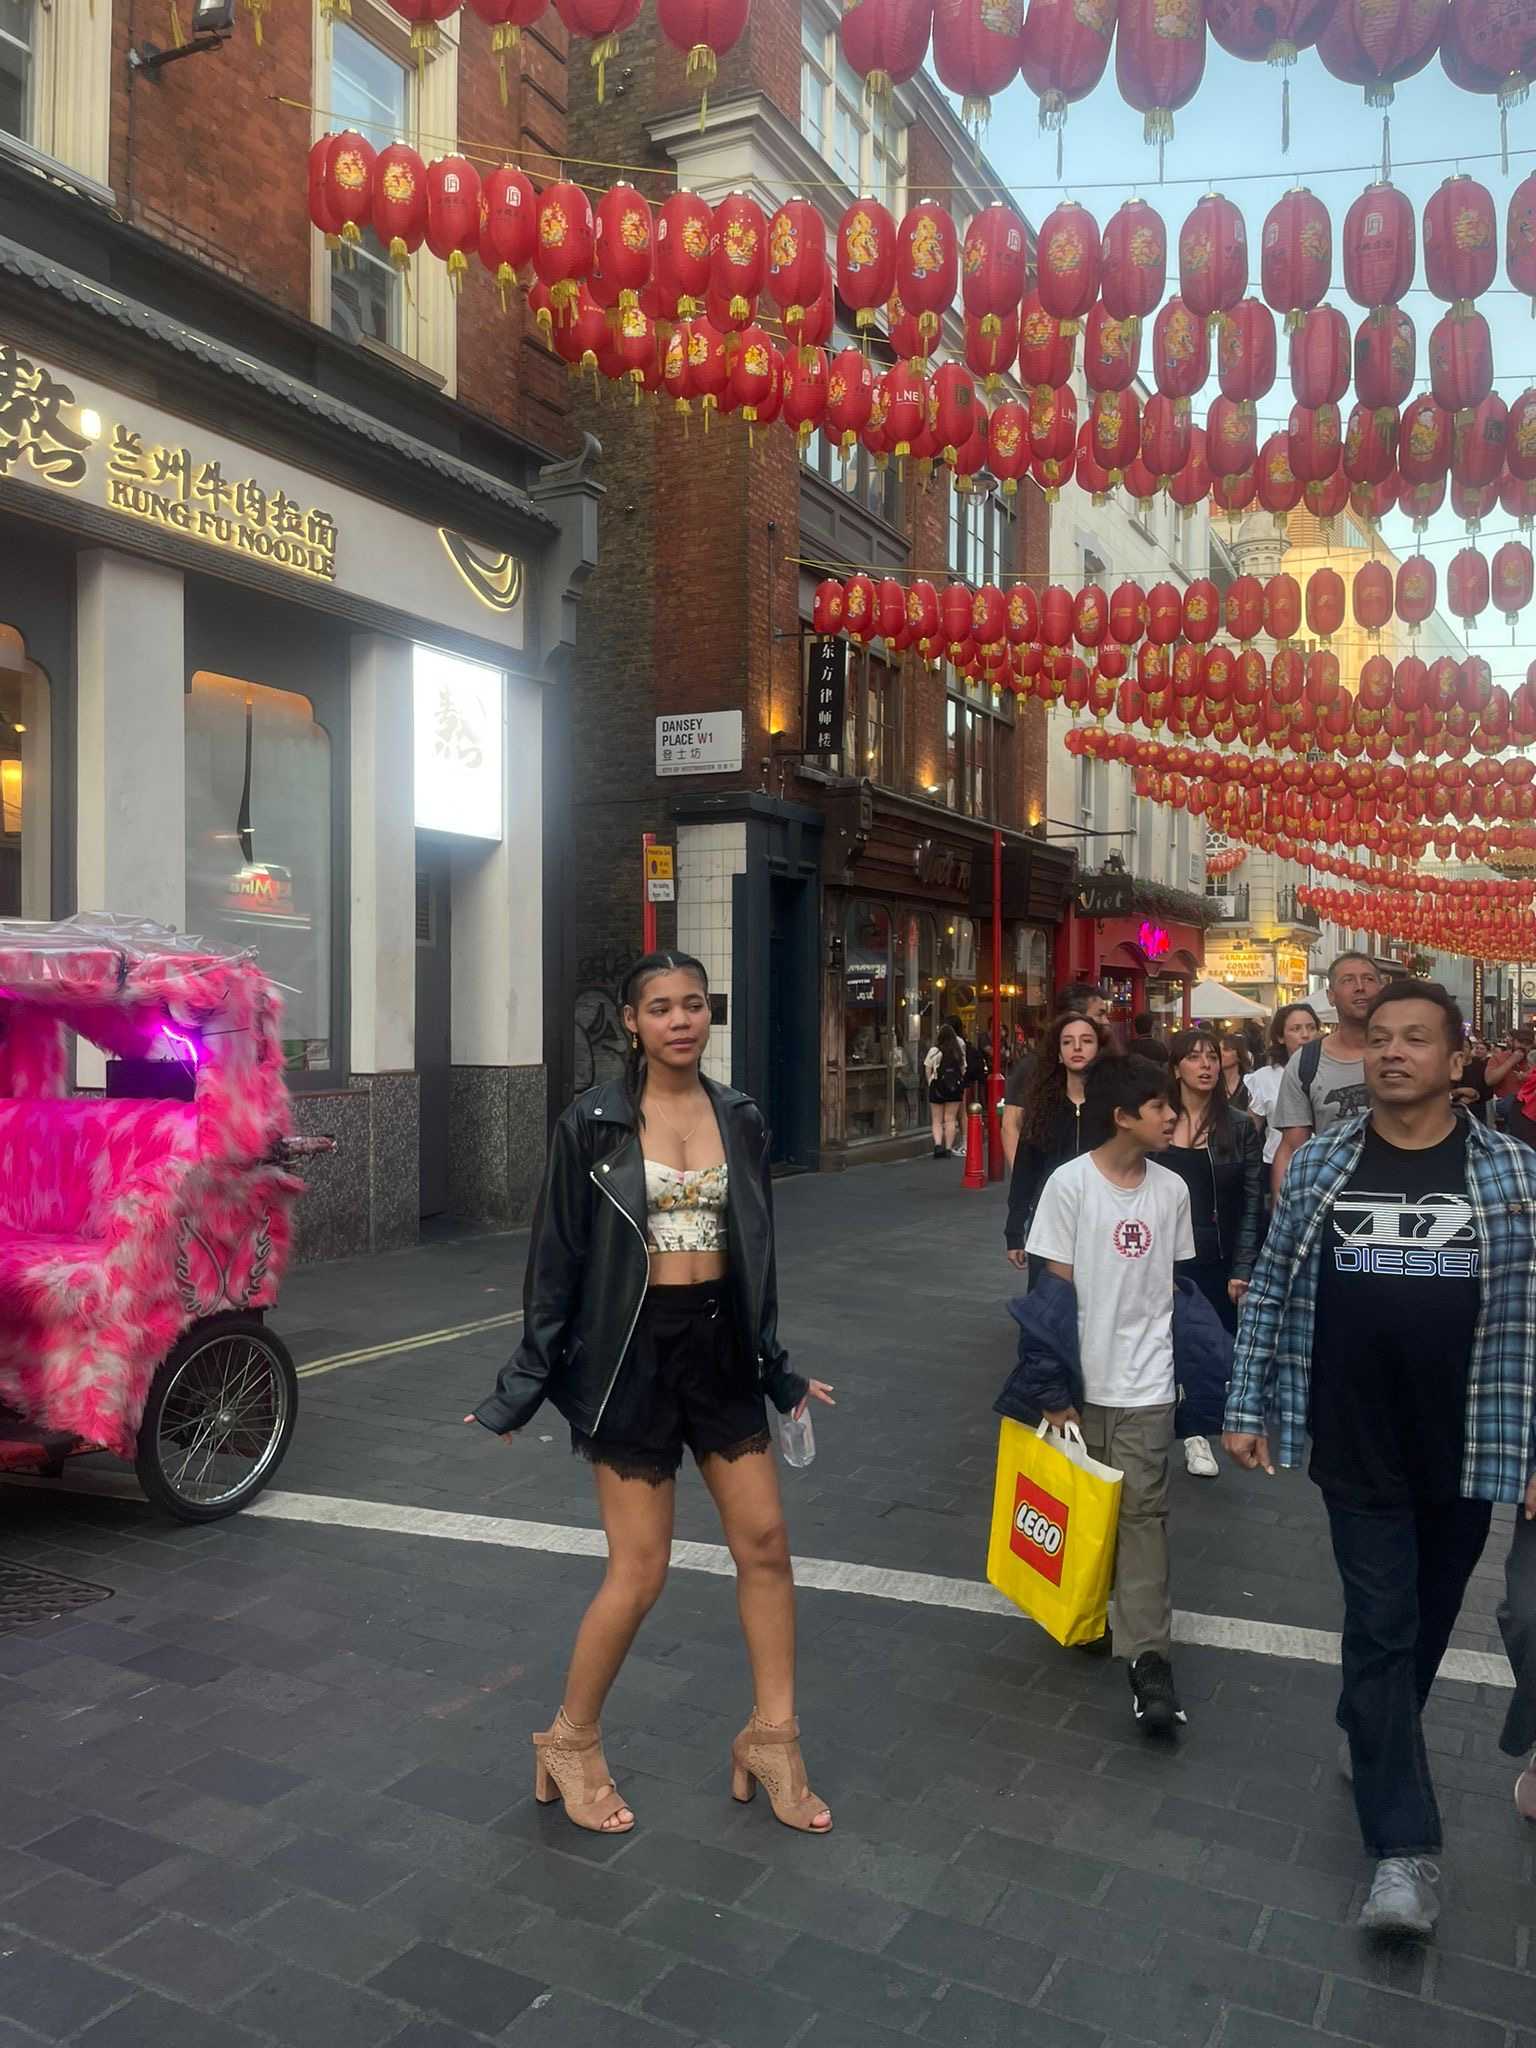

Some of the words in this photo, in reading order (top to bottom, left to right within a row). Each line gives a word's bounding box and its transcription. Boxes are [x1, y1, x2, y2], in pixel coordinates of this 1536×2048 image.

[109, 424, 338, 555] 兰州牛肉拉面
[111, 479, 191, 529] KUNG
[198, 510, 232, 542] FU
[238, 524, 336, 581] NOODLE
[662, 718, 703, 733] DANSEY
[818, 643, 836, 748] 东方律师楼
[662, 733, 694, 747] PLACE
[697, 732, 713, 745] W1
[1016, 1502, 1062, 1554] LEGO
